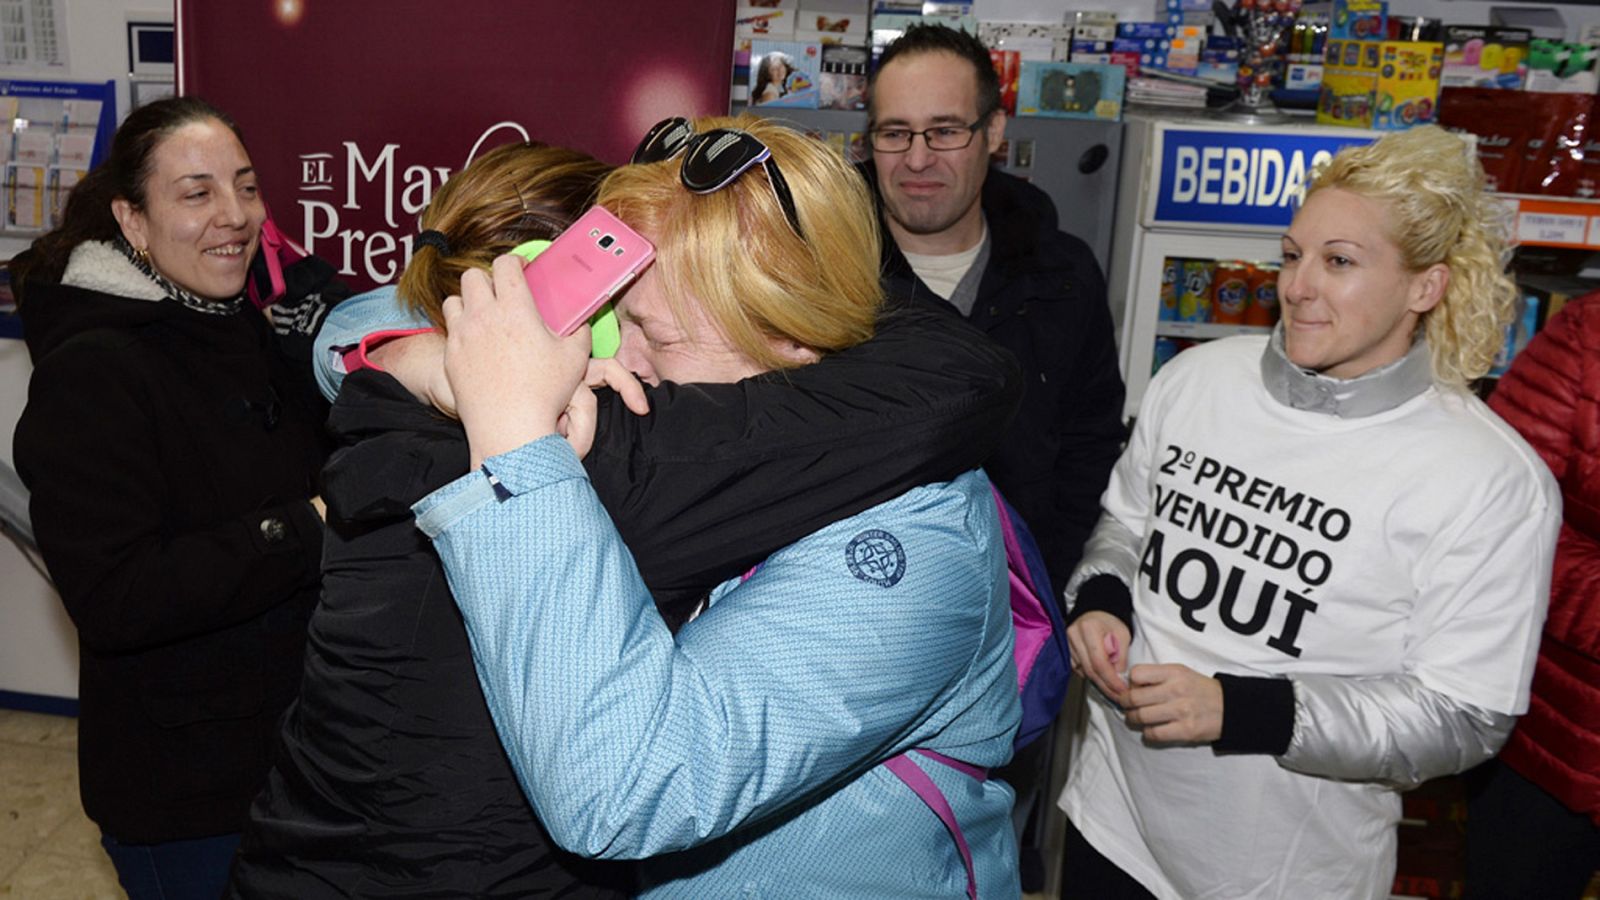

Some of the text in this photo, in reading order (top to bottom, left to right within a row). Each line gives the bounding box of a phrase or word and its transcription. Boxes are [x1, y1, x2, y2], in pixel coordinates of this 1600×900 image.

[302, 160, 333, 184] EL
[297, 199, 414, 285] Pre
[1154, 483, 1333, 586] VENDIDO
[1193, 456, 1352, 542] PREMIO
[1138, 528, 1319, 659] AQUÍ
